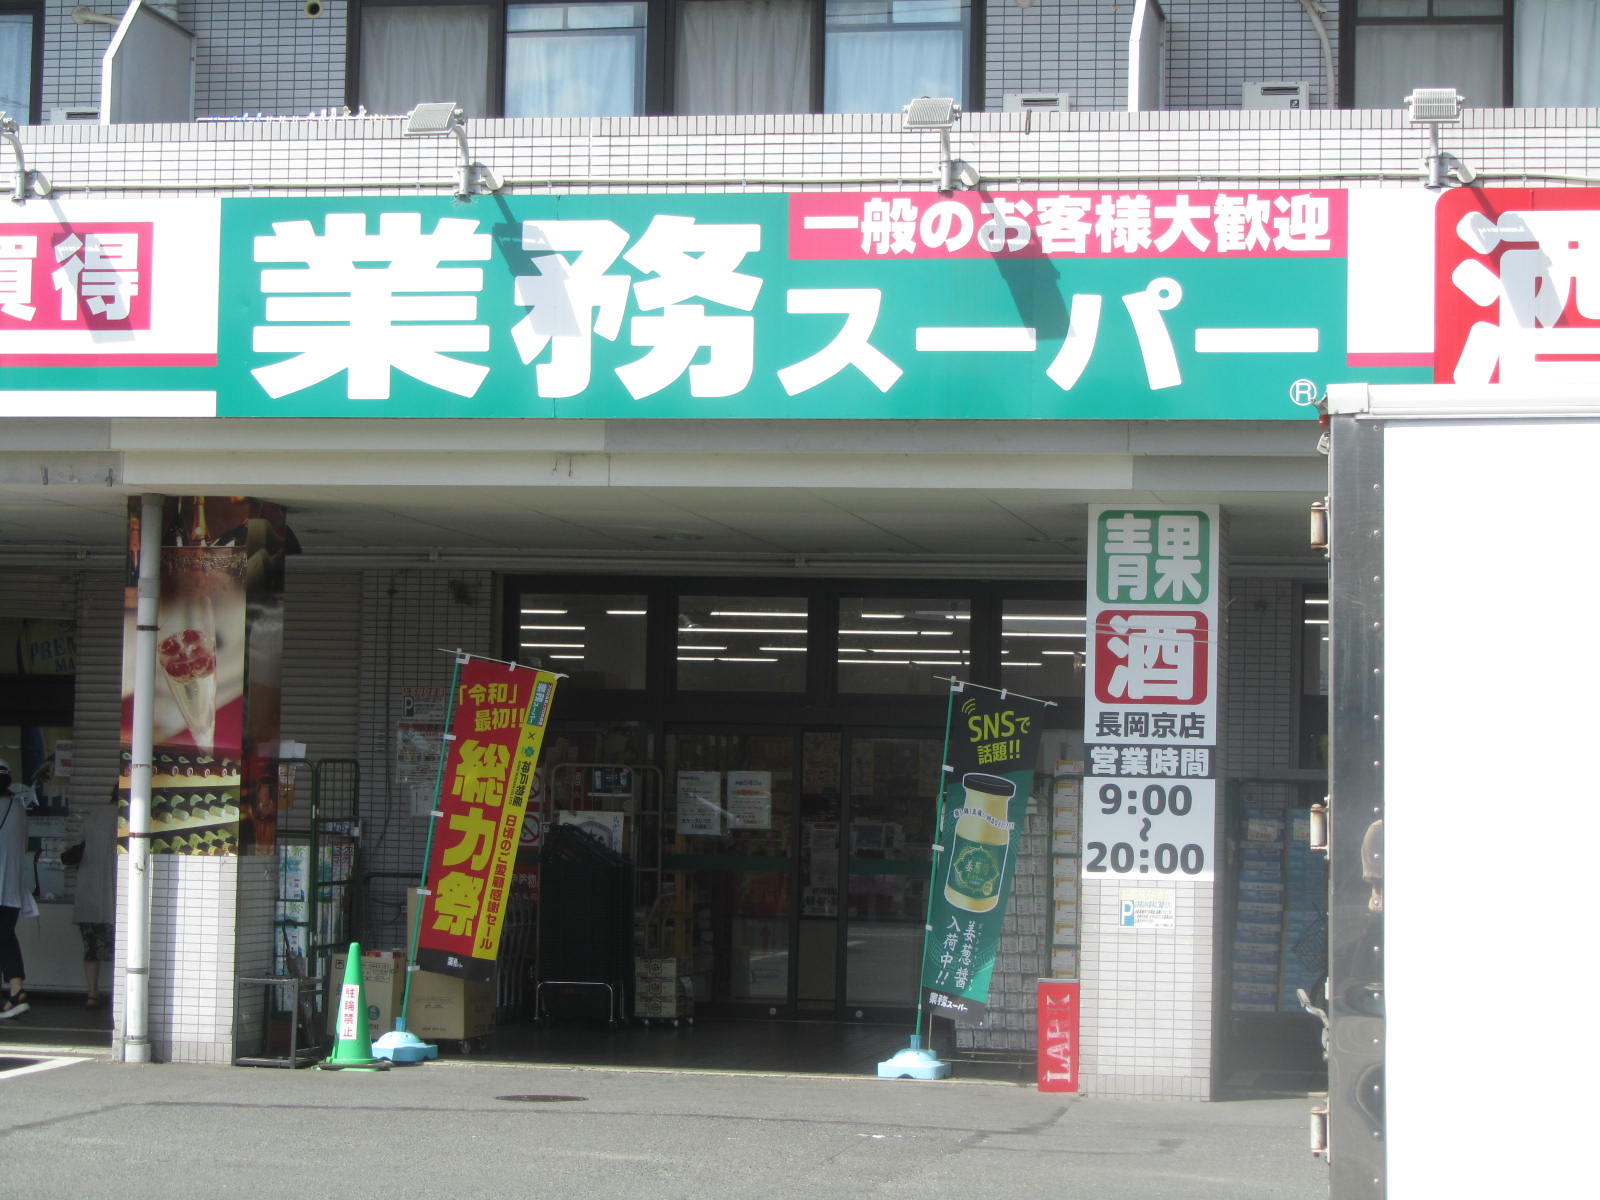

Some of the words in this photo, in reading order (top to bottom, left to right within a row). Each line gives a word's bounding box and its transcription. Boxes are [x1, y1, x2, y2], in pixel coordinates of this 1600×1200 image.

[803, 195, 1331, 255] 一般のお客様大歓迎
[250, 212, 1319, 401] 業務スーパー
[1104, 513, 1201, 602] 青果
[1107, 614, 1197, 700] 酒
[459, 683, 518, 706] 「令和」
[968, 710, 1031, 743] SNSで
[1095, 711, 1206, 739] 長岡京店
[977, 739, 1020, 765] 話題!!
[1090, 746, 1209, 777] 営業時間
[1099, 783, 1193, 816] 9:00
[432, 739, 511, 937] 総力祭
[1086, 842, 1205, 875] 20:00
[928, 991, 969, 1013] 業務スーパー
